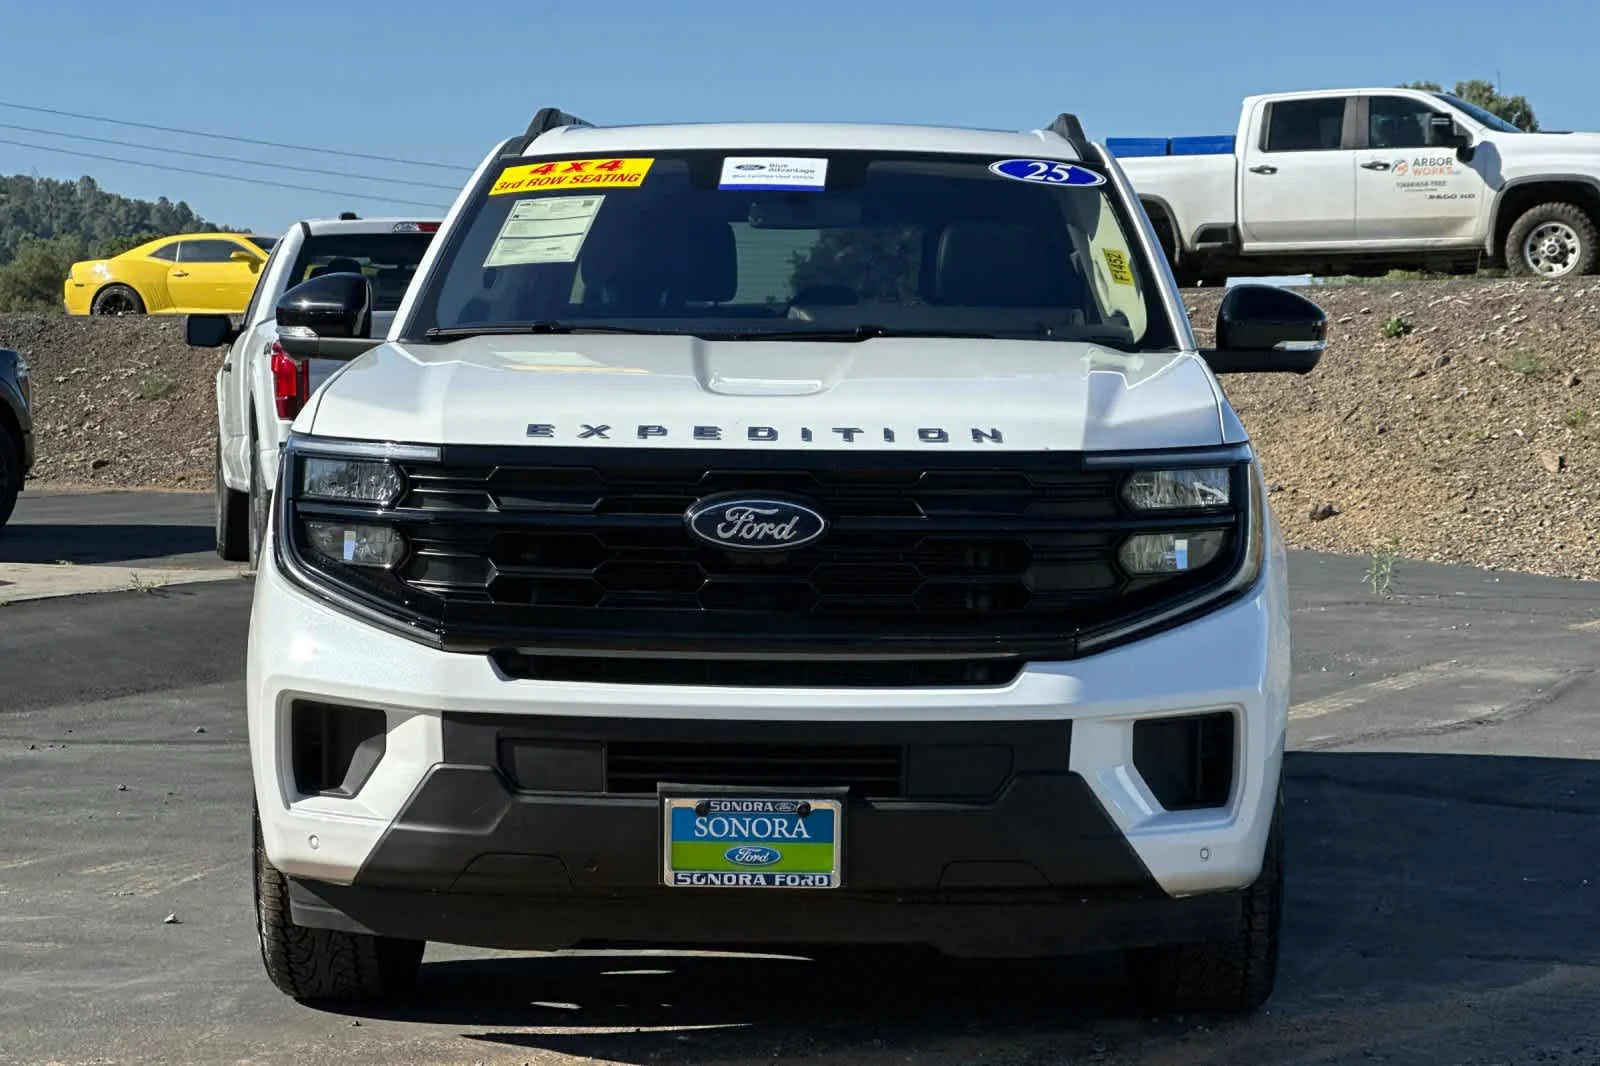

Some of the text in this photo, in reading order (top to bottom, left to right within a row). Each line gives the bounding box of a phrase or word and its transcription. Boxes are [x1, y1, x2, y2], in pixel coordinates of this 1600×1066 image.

[1412, 157, 1453, 167] ARBOR
[1024, 161, 1073, 182] 25
[1413, 166, 1454, 176] WORKS
[494, 172, 642, 191] 3rd ROW SEATING
[526, 423, 1004, 443] EXPEDITION
[716, 506, 799, 539] Ford
[709, 801, 773, 811] SONORA
[694, 816, 811, 839] SONORA
[735, 847, 770, 863] Ford
[676, 872, 831, 887] SONORA FORD
